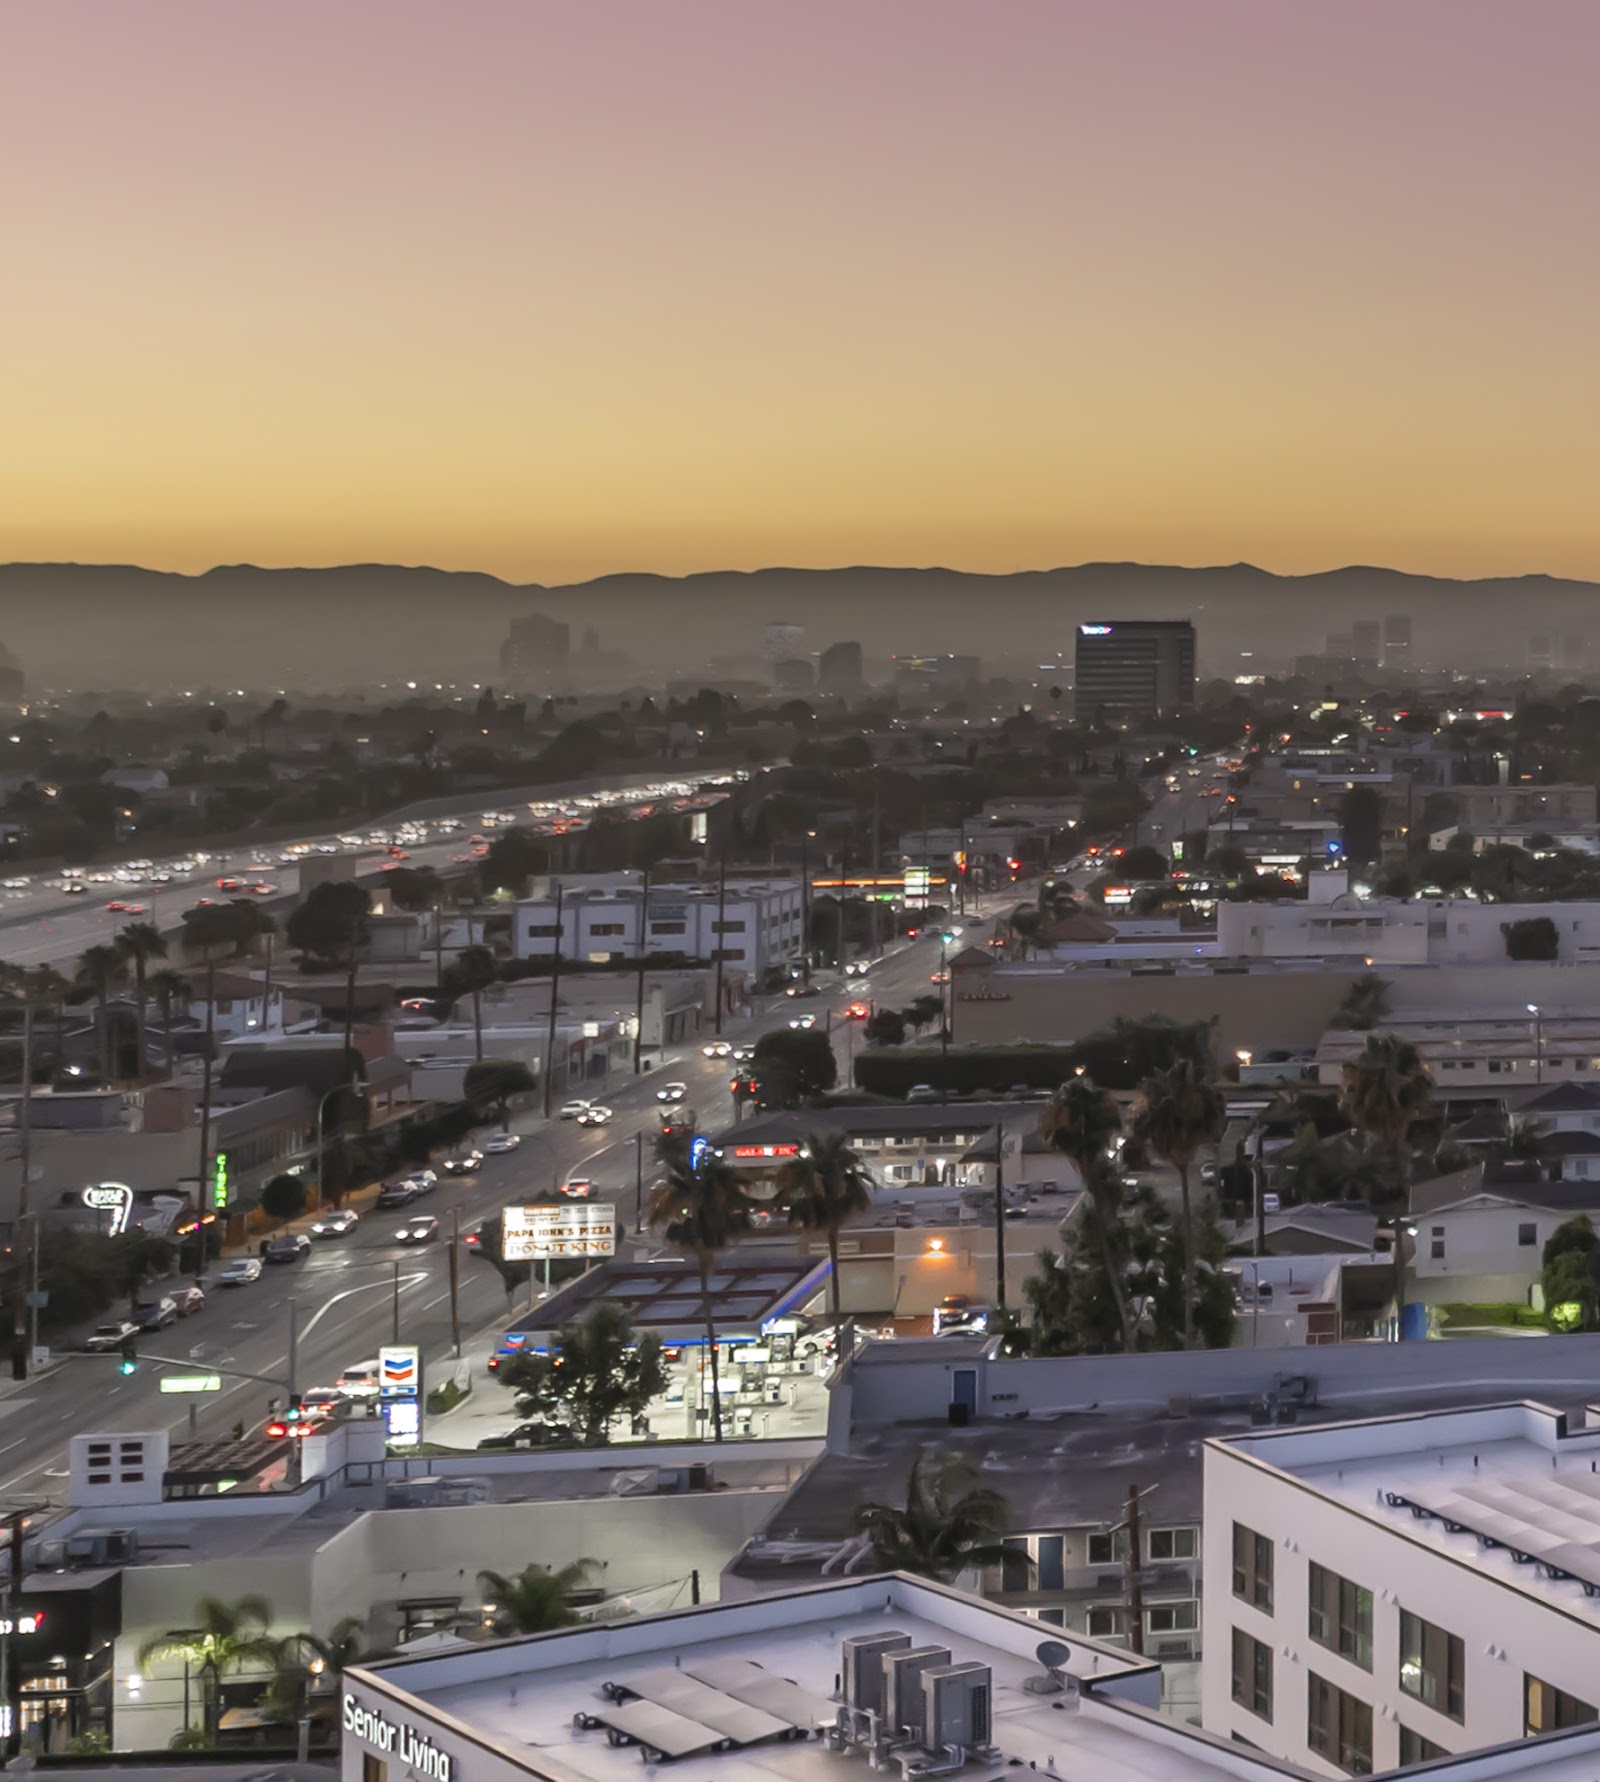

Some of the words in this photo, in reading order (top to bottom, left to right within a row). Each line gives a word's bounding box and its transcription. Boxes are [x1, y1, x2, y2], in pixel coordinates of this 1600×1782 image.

[735, 1146, 777, 1157] GALAY
[215, 1153, 227, 1208] CINEMA
[507, 1229, 534, 1239] PAPA
[538, 1227, 574, 1237] JOHN'S
[579, 1225, 612, 1235] PIZZA
[509, 1242, 566, 1254] DONUT
[570, 1241, 612, 1252] KING
[343, 1693, 397, 1752] Senior
